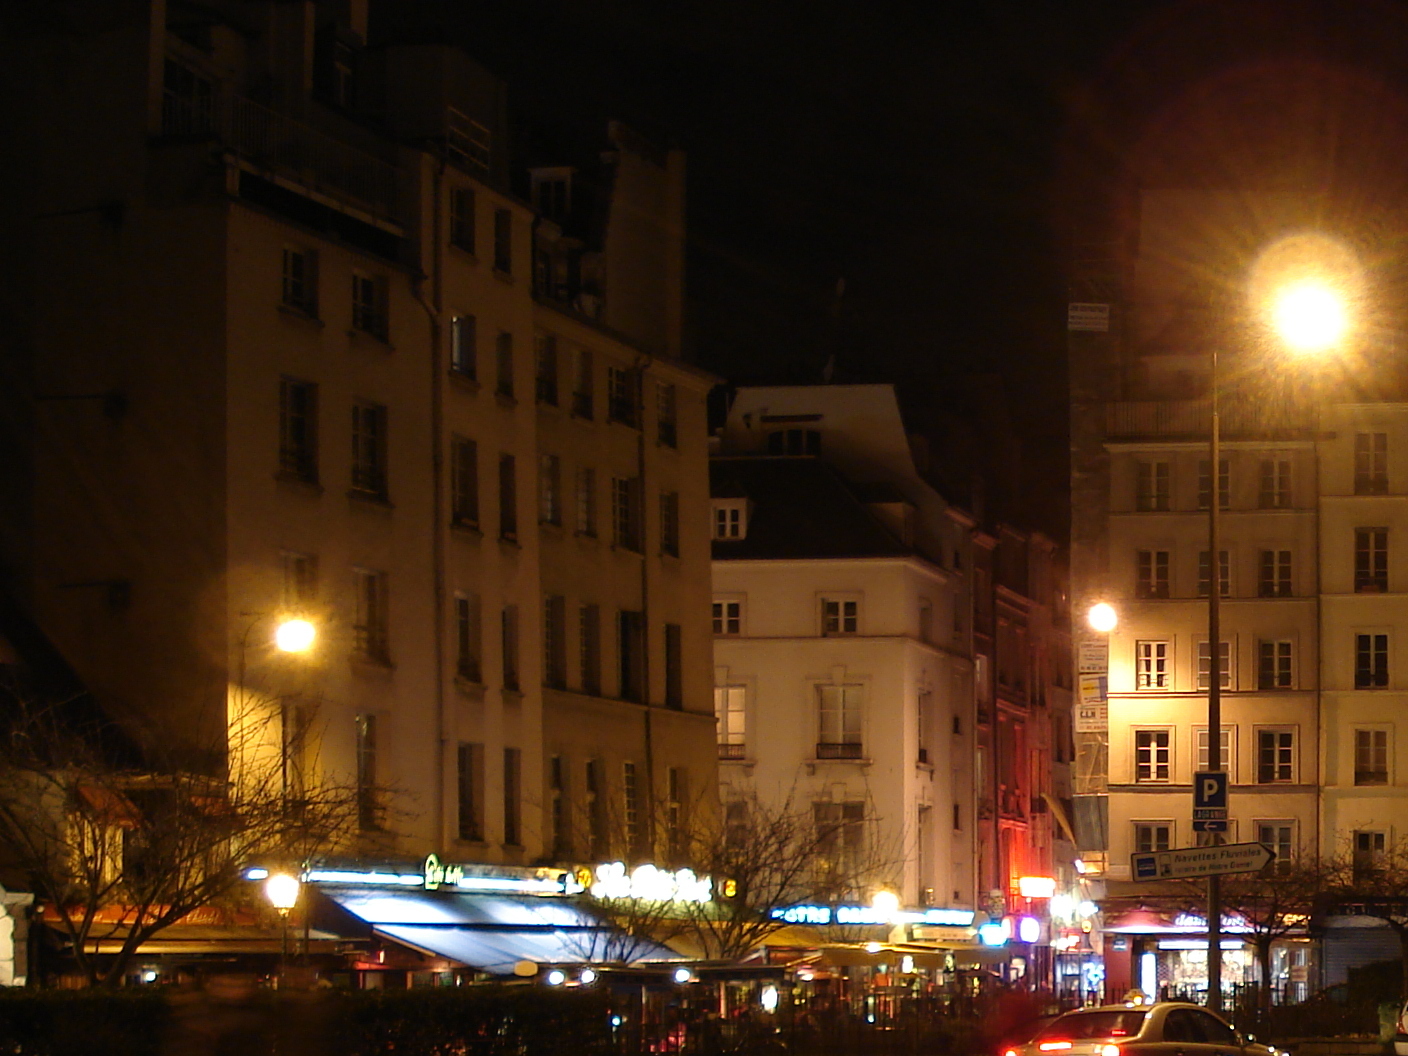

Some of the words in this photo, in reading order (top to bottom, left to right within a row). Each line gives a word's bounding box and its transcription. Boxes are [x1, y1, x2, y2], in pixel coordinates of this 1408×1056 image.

[1203, 779, 1219, 802] P
[1174, 852, 1217, 863] Navettes
[1221, 847, 1262, 859] Fluviales
